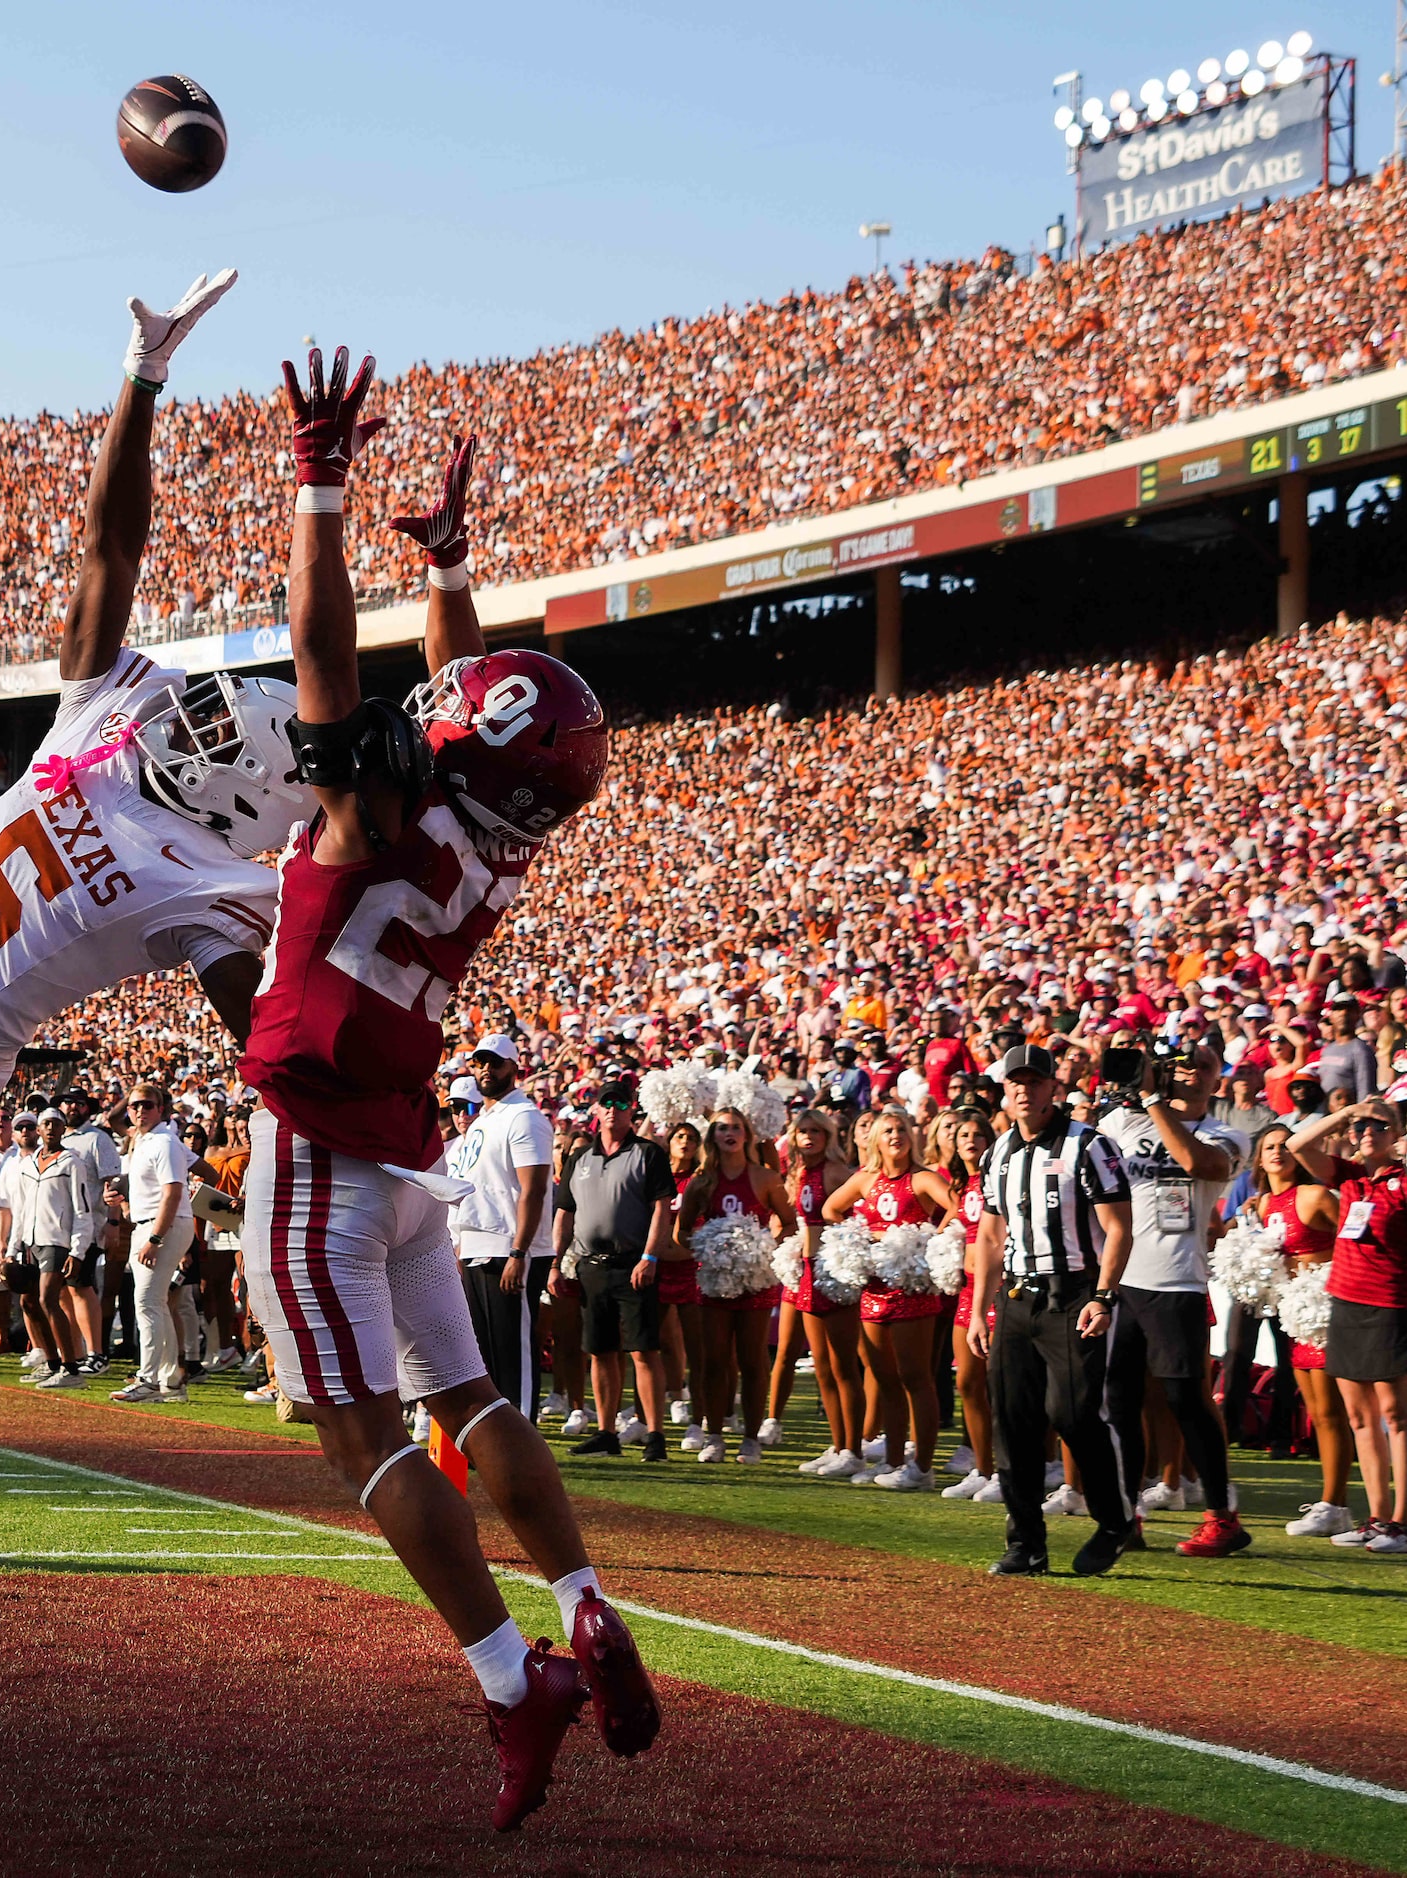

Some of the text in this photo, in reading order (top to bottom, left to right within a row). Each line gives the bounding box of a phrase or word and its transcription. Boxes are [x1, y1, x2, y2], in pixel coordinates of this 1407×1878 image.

[1180, 436, 1282, 484] TEXAS 21
[1307, 427, 1361, 463] 3 17
[39, 757, 136, 907] EXAS
[1000, 1163, 1009, 1175] S
[1047, 1191, 1059, 1208] S
